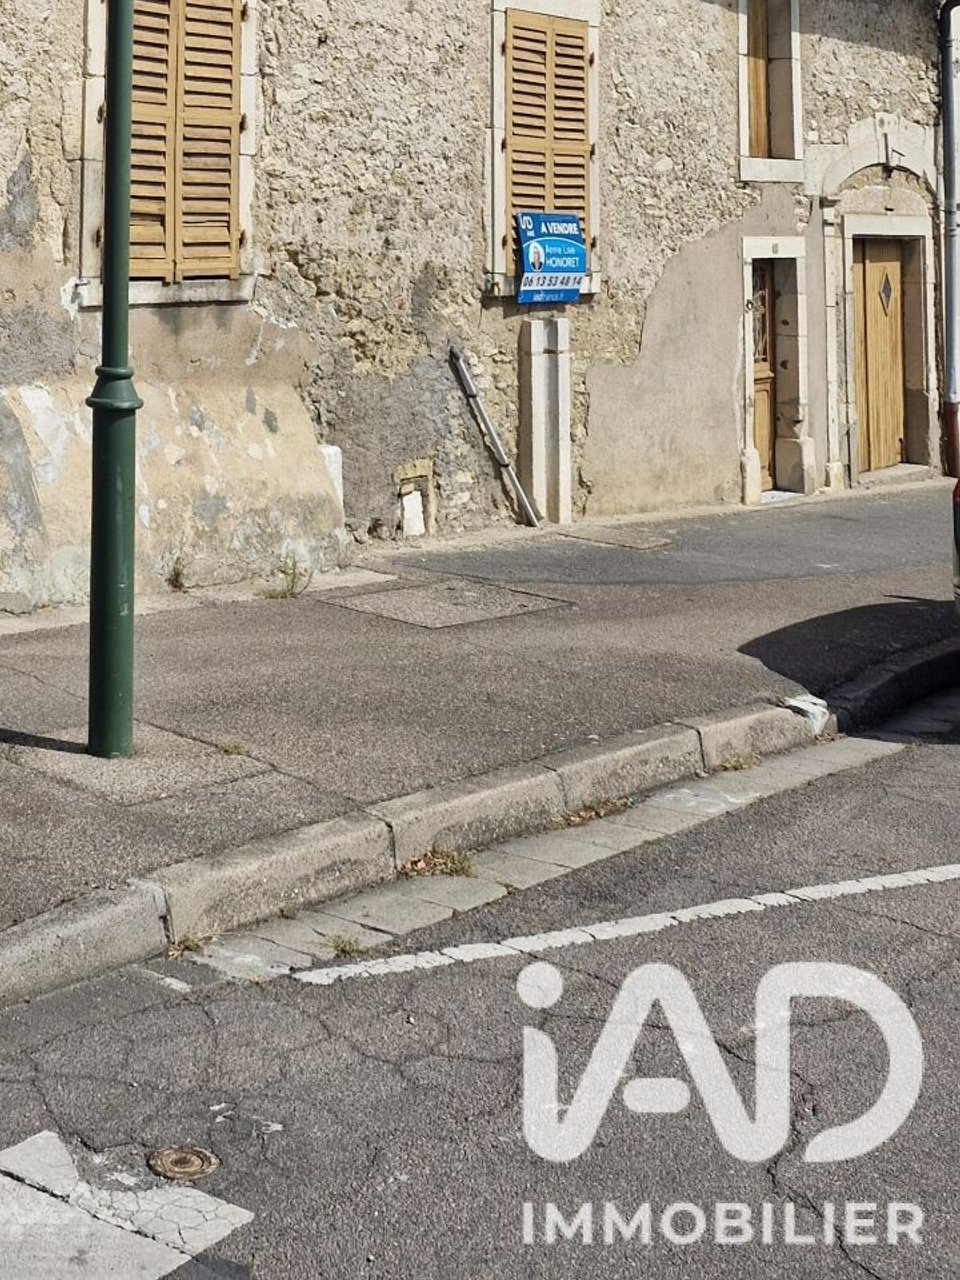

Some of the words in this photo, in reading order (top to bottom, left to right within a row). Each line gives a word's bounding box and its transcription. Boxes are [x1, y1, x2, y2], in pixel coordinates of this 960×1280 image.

[541, 222, 548, 234] A
[547, 222, 579, 235] VENDRE
[523, 276, 533, 287] 06
